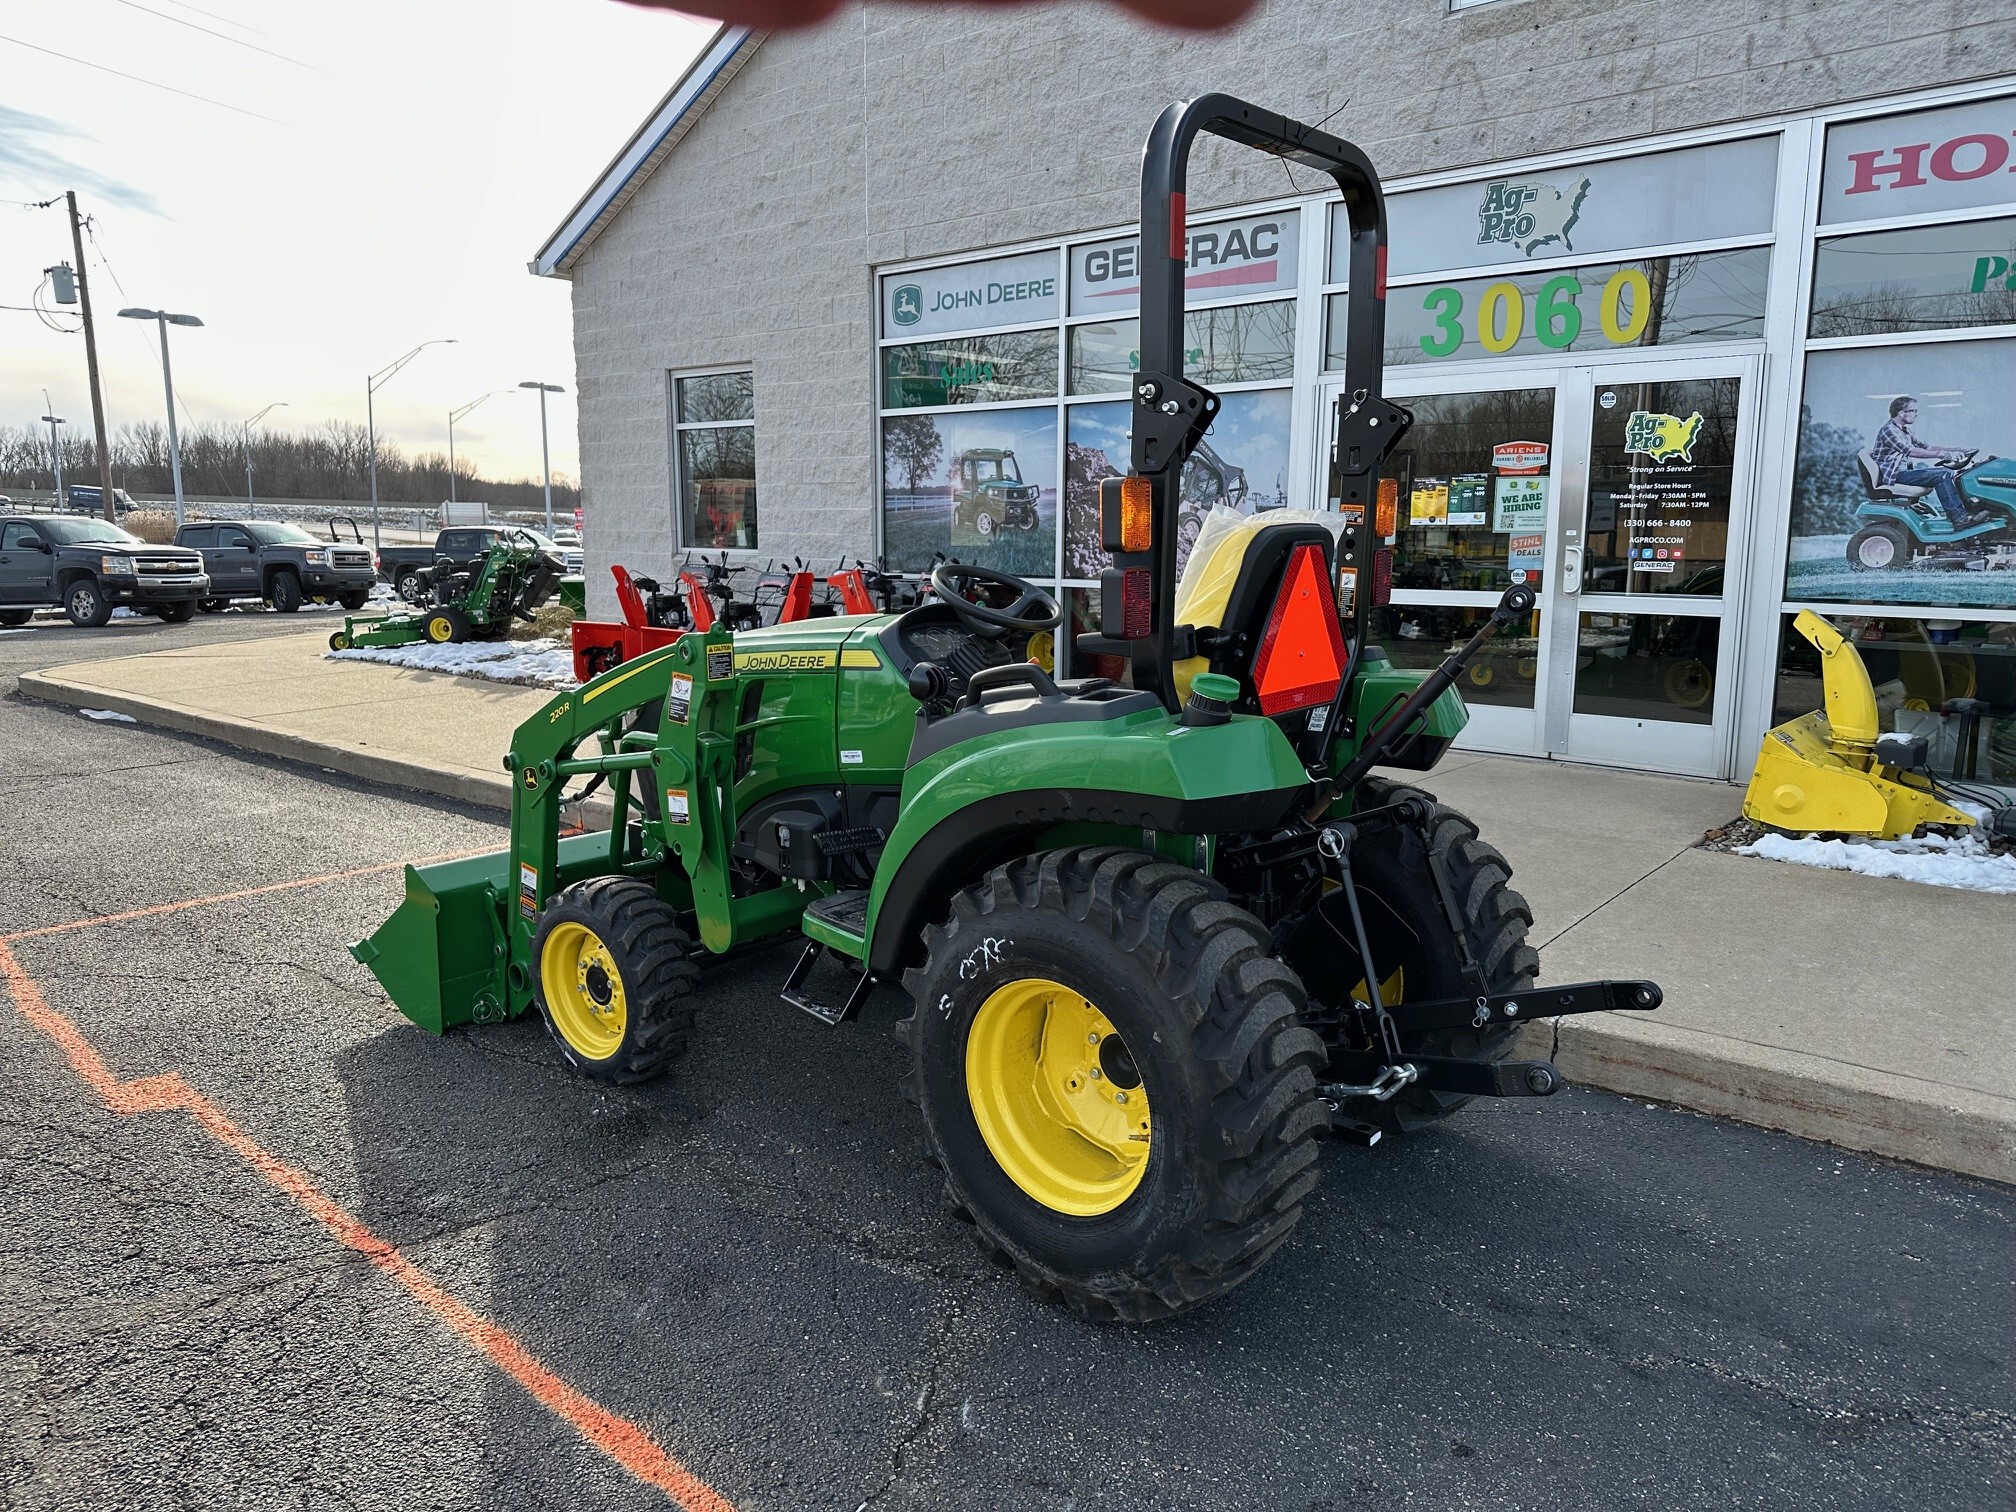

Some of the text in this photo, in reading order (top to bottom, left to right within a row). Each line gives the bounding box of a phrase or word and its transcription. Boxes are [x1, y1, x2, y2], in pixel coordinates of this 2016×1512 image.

[1845, 130, 2016, 195] HO
[1480, 181, 1538, 216] Ag-
[1478, 212, 1535, 244] Pro
[1084, 222, 1280, 282] GERAC
[931, 278, 1055, 312] JOHN DEERE
[1420, 269, 1651, 357] 3060
[1629, 413, 1667, 436] Ag-
[1498, 446, 1542, 454] ARIENS
[1625, 432, 1666, 451] Pro
[1501, 493, 1543, 504] WE ARE
[1502, 502, 1541, 513] HIRING
[1624, 519, 1645, 527] (330)
[1646, 519, 1663, 527] 666
[1669, 519, 1692, 527] 8400
[1512, 536, 1540, 548] STIHL
[742, 656, 777, 668] JOHN
[779, 654, 825, 667] DEERE
